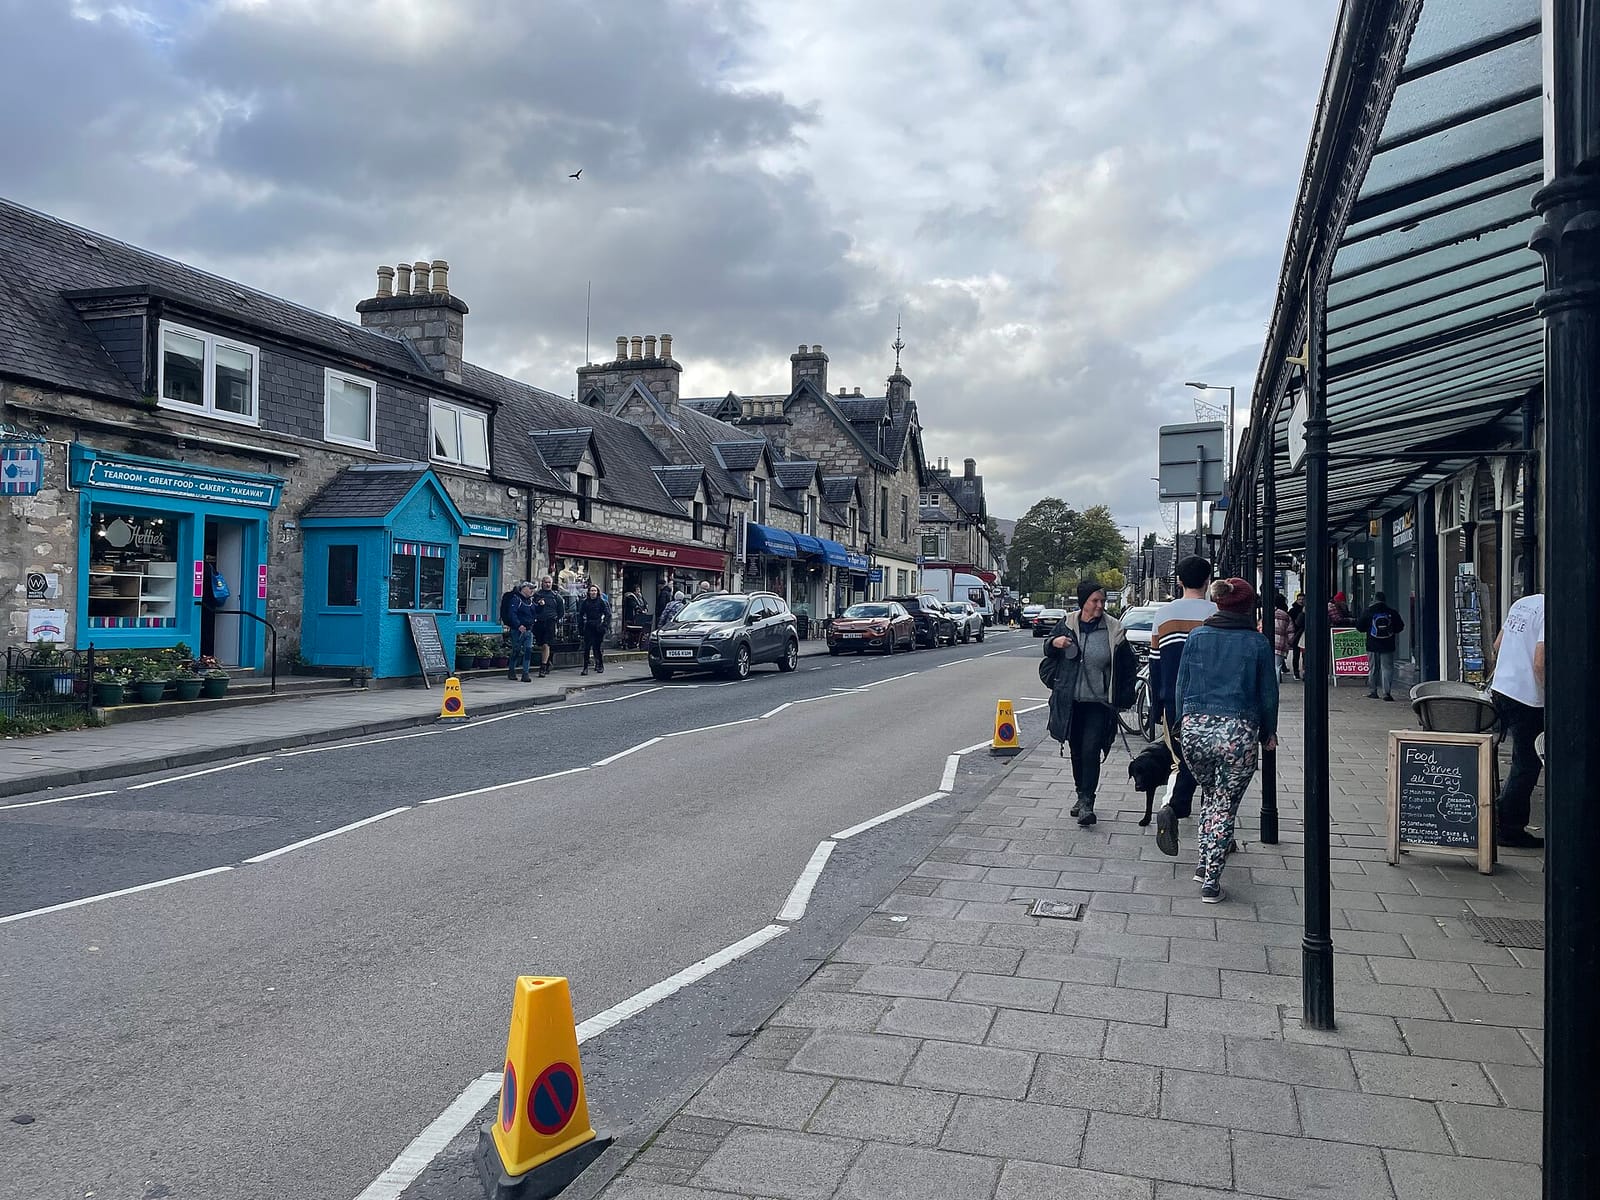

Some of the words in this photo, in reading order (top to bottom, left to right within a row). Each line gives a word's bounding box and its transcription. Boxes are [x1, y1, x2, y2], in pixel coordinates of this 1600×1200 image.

[104, 470, 143, 482] TEAROOM
[149, 476, 173, 487] GREAT
[173, 479, 194, 489] FOOD
[199, 483, 226, 493] CAKERY
[230, 487, 264, 498] TAKEAWAY
[130, 524, 165, 548] Hettie's
[1406, 748, 1438, 764] Food
[1433, 775, 1461, 794] Day
